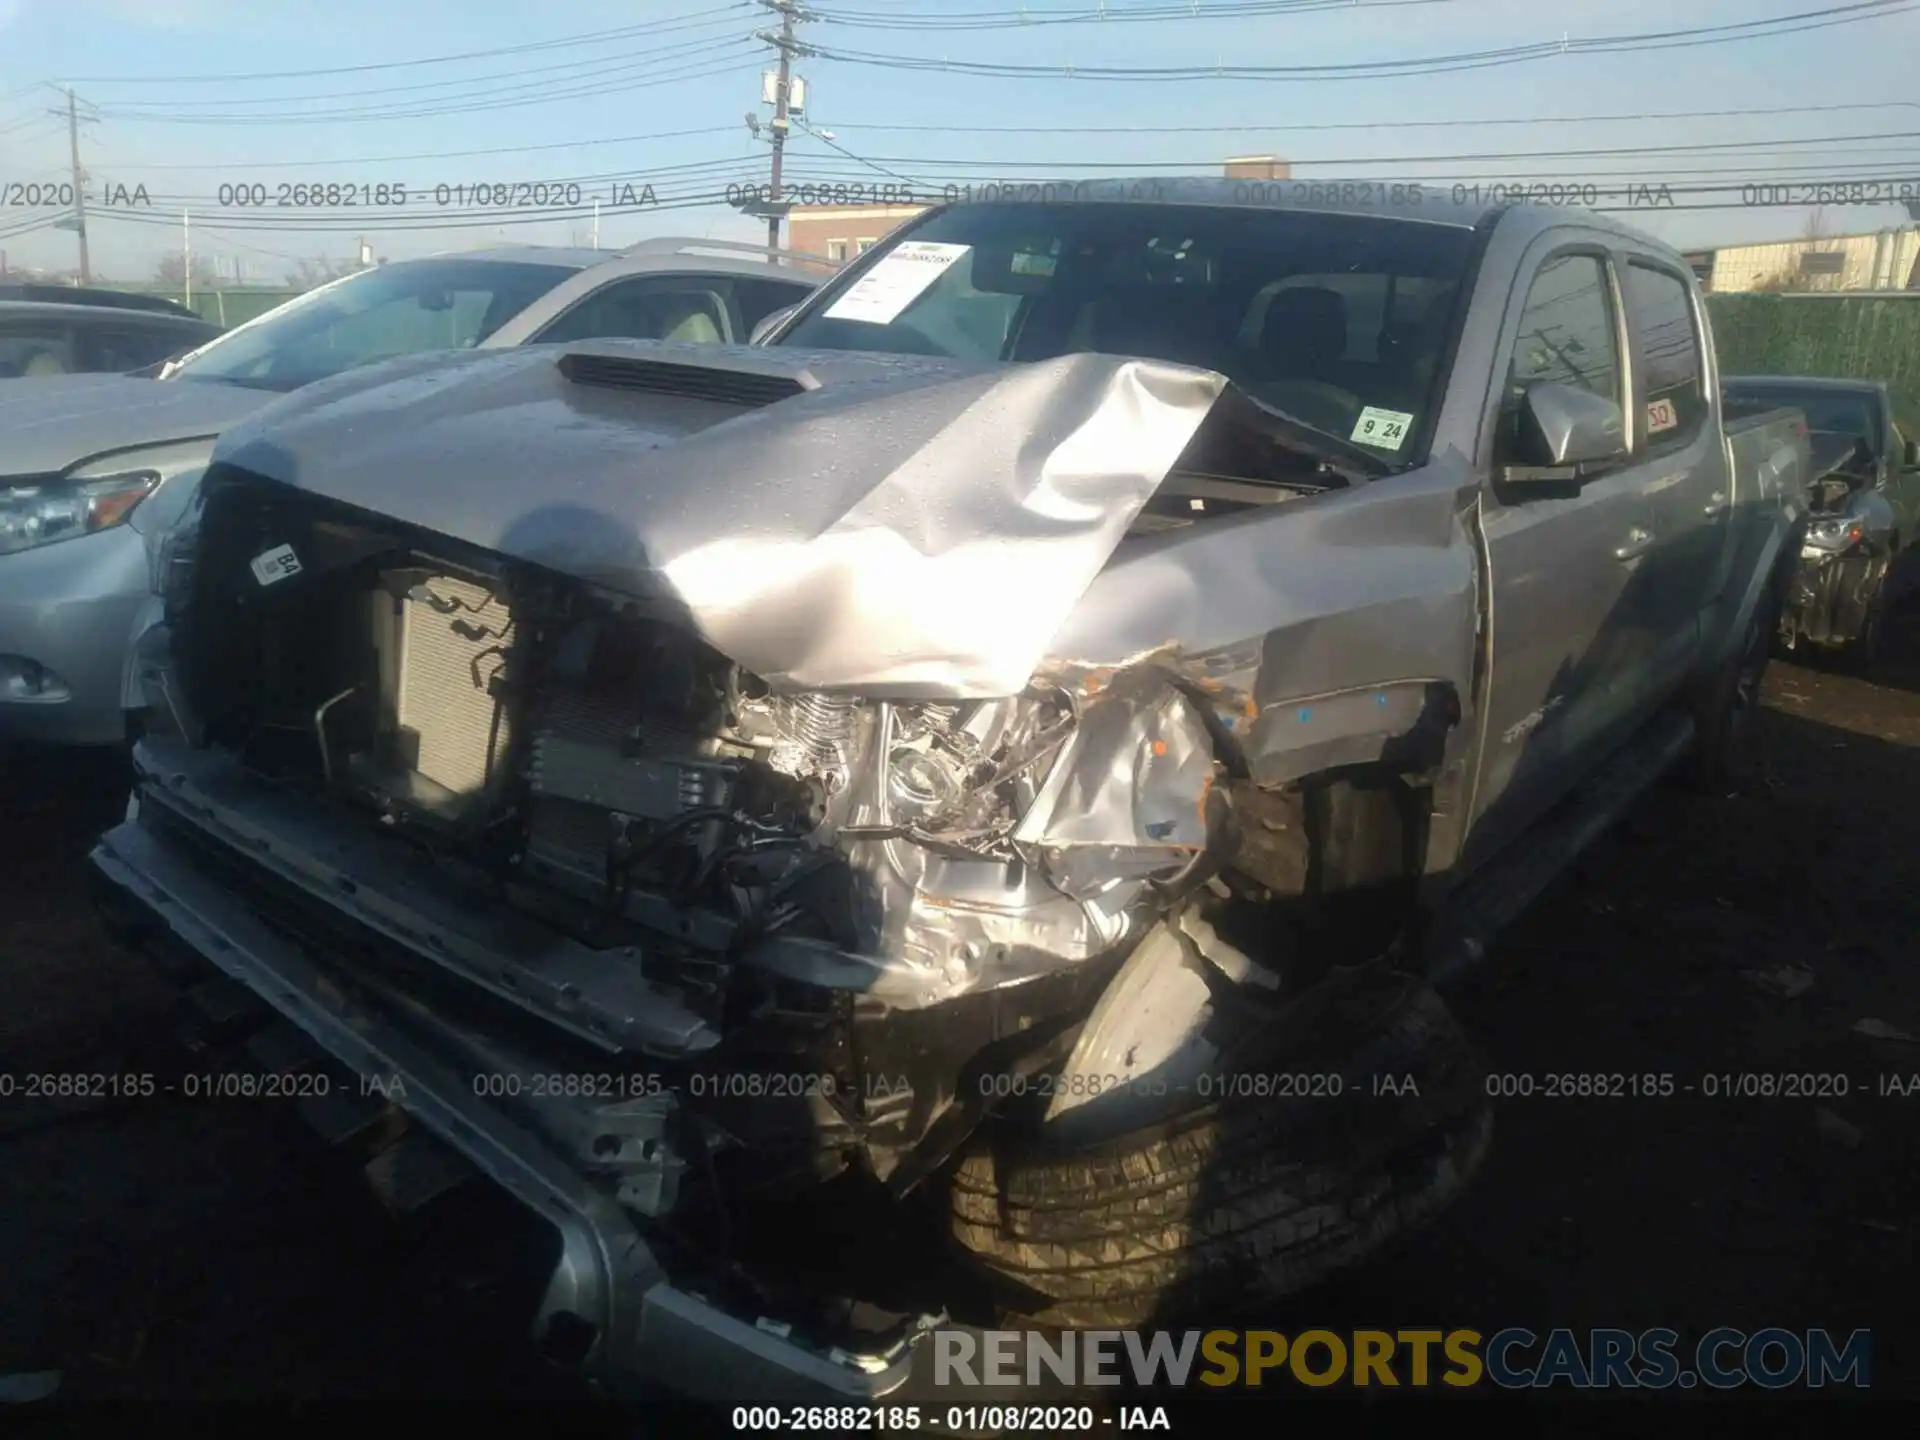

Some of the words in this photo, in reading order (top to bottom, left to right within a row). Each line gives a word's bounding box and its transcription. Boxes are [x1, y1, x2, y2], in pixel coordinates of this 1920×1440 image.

[1364, 420, 1375, 434] 9
[1382, 423, 1402, 438] 24
[277, 553, 300, 574] B4
